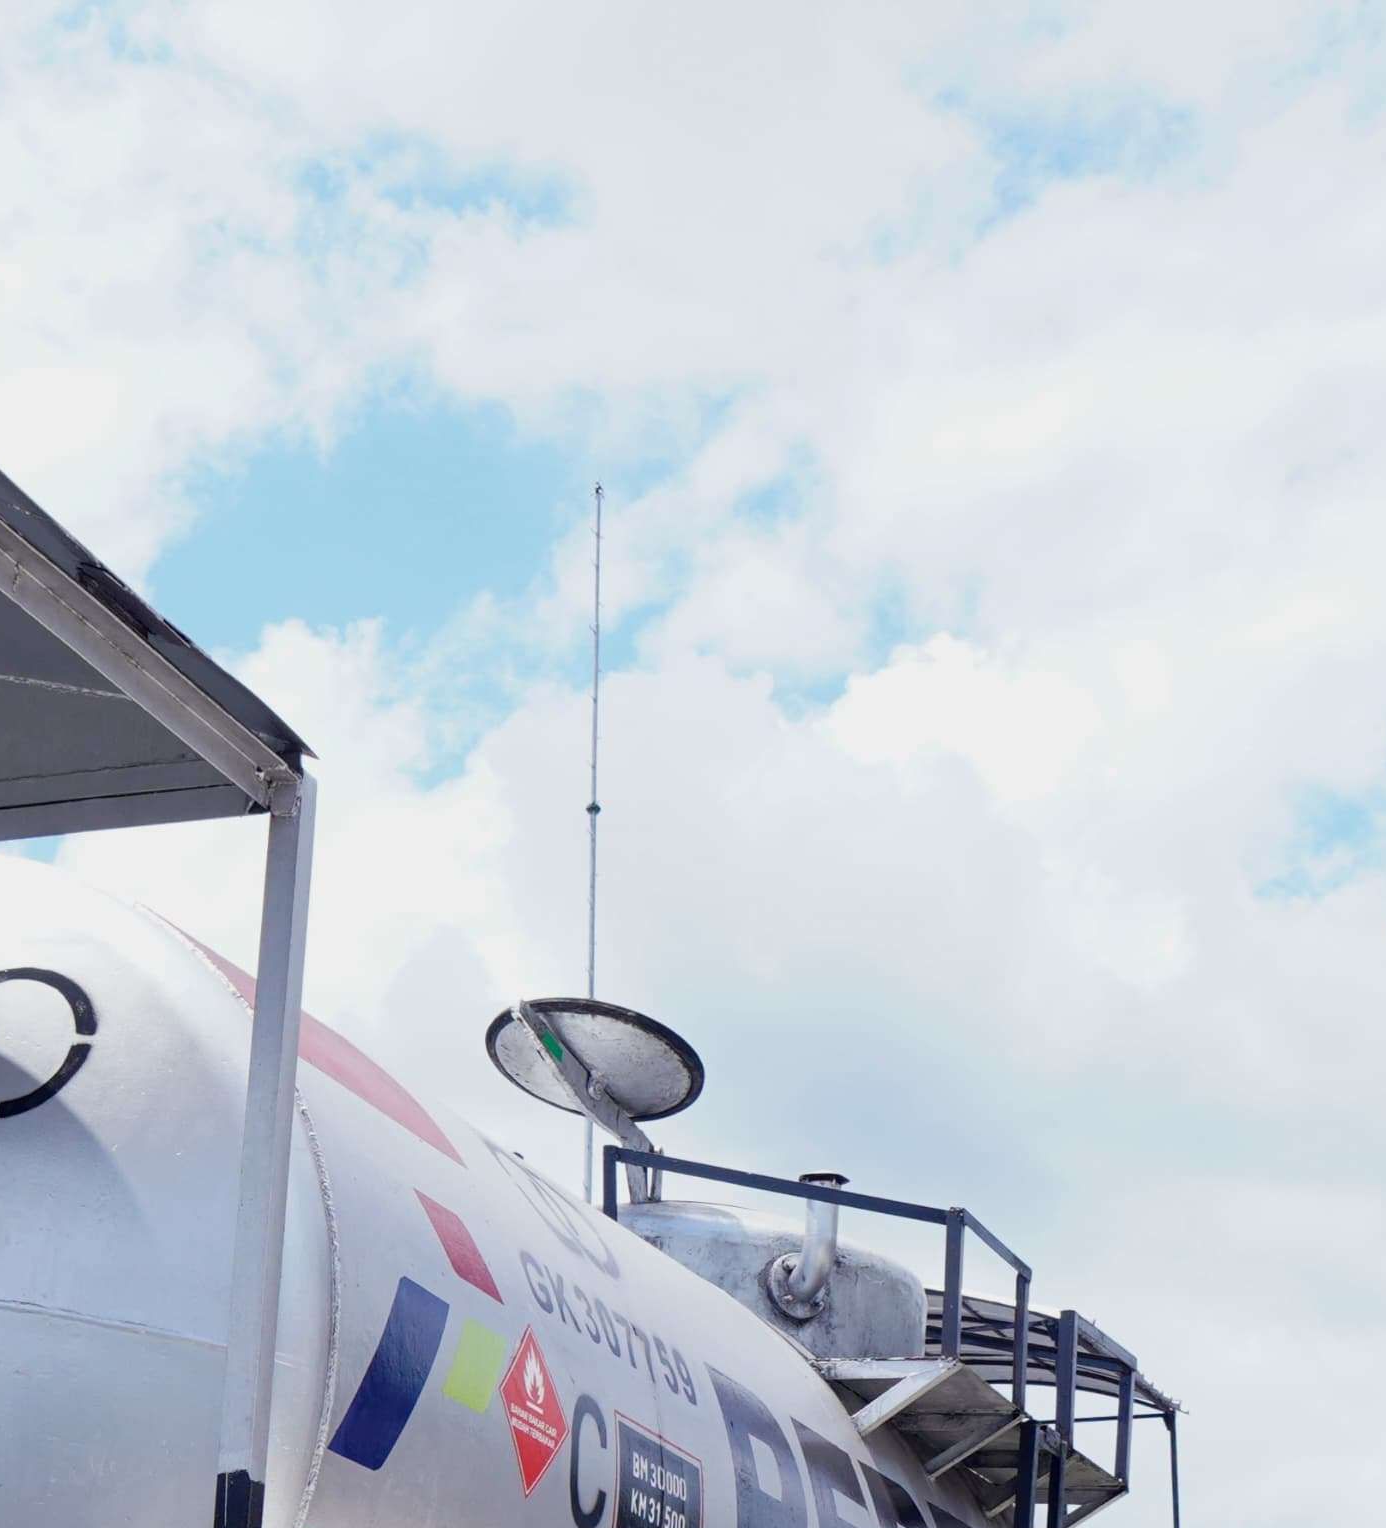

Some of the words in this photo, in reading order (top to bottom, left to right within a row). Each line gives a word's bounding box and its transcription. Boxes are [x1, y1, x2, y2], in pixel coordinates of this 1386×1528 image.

[520, 1250, 698, 1407] GK307759
[632, 1452, 648, 1481] BM
[630, 1488, 647, 1520] KM
